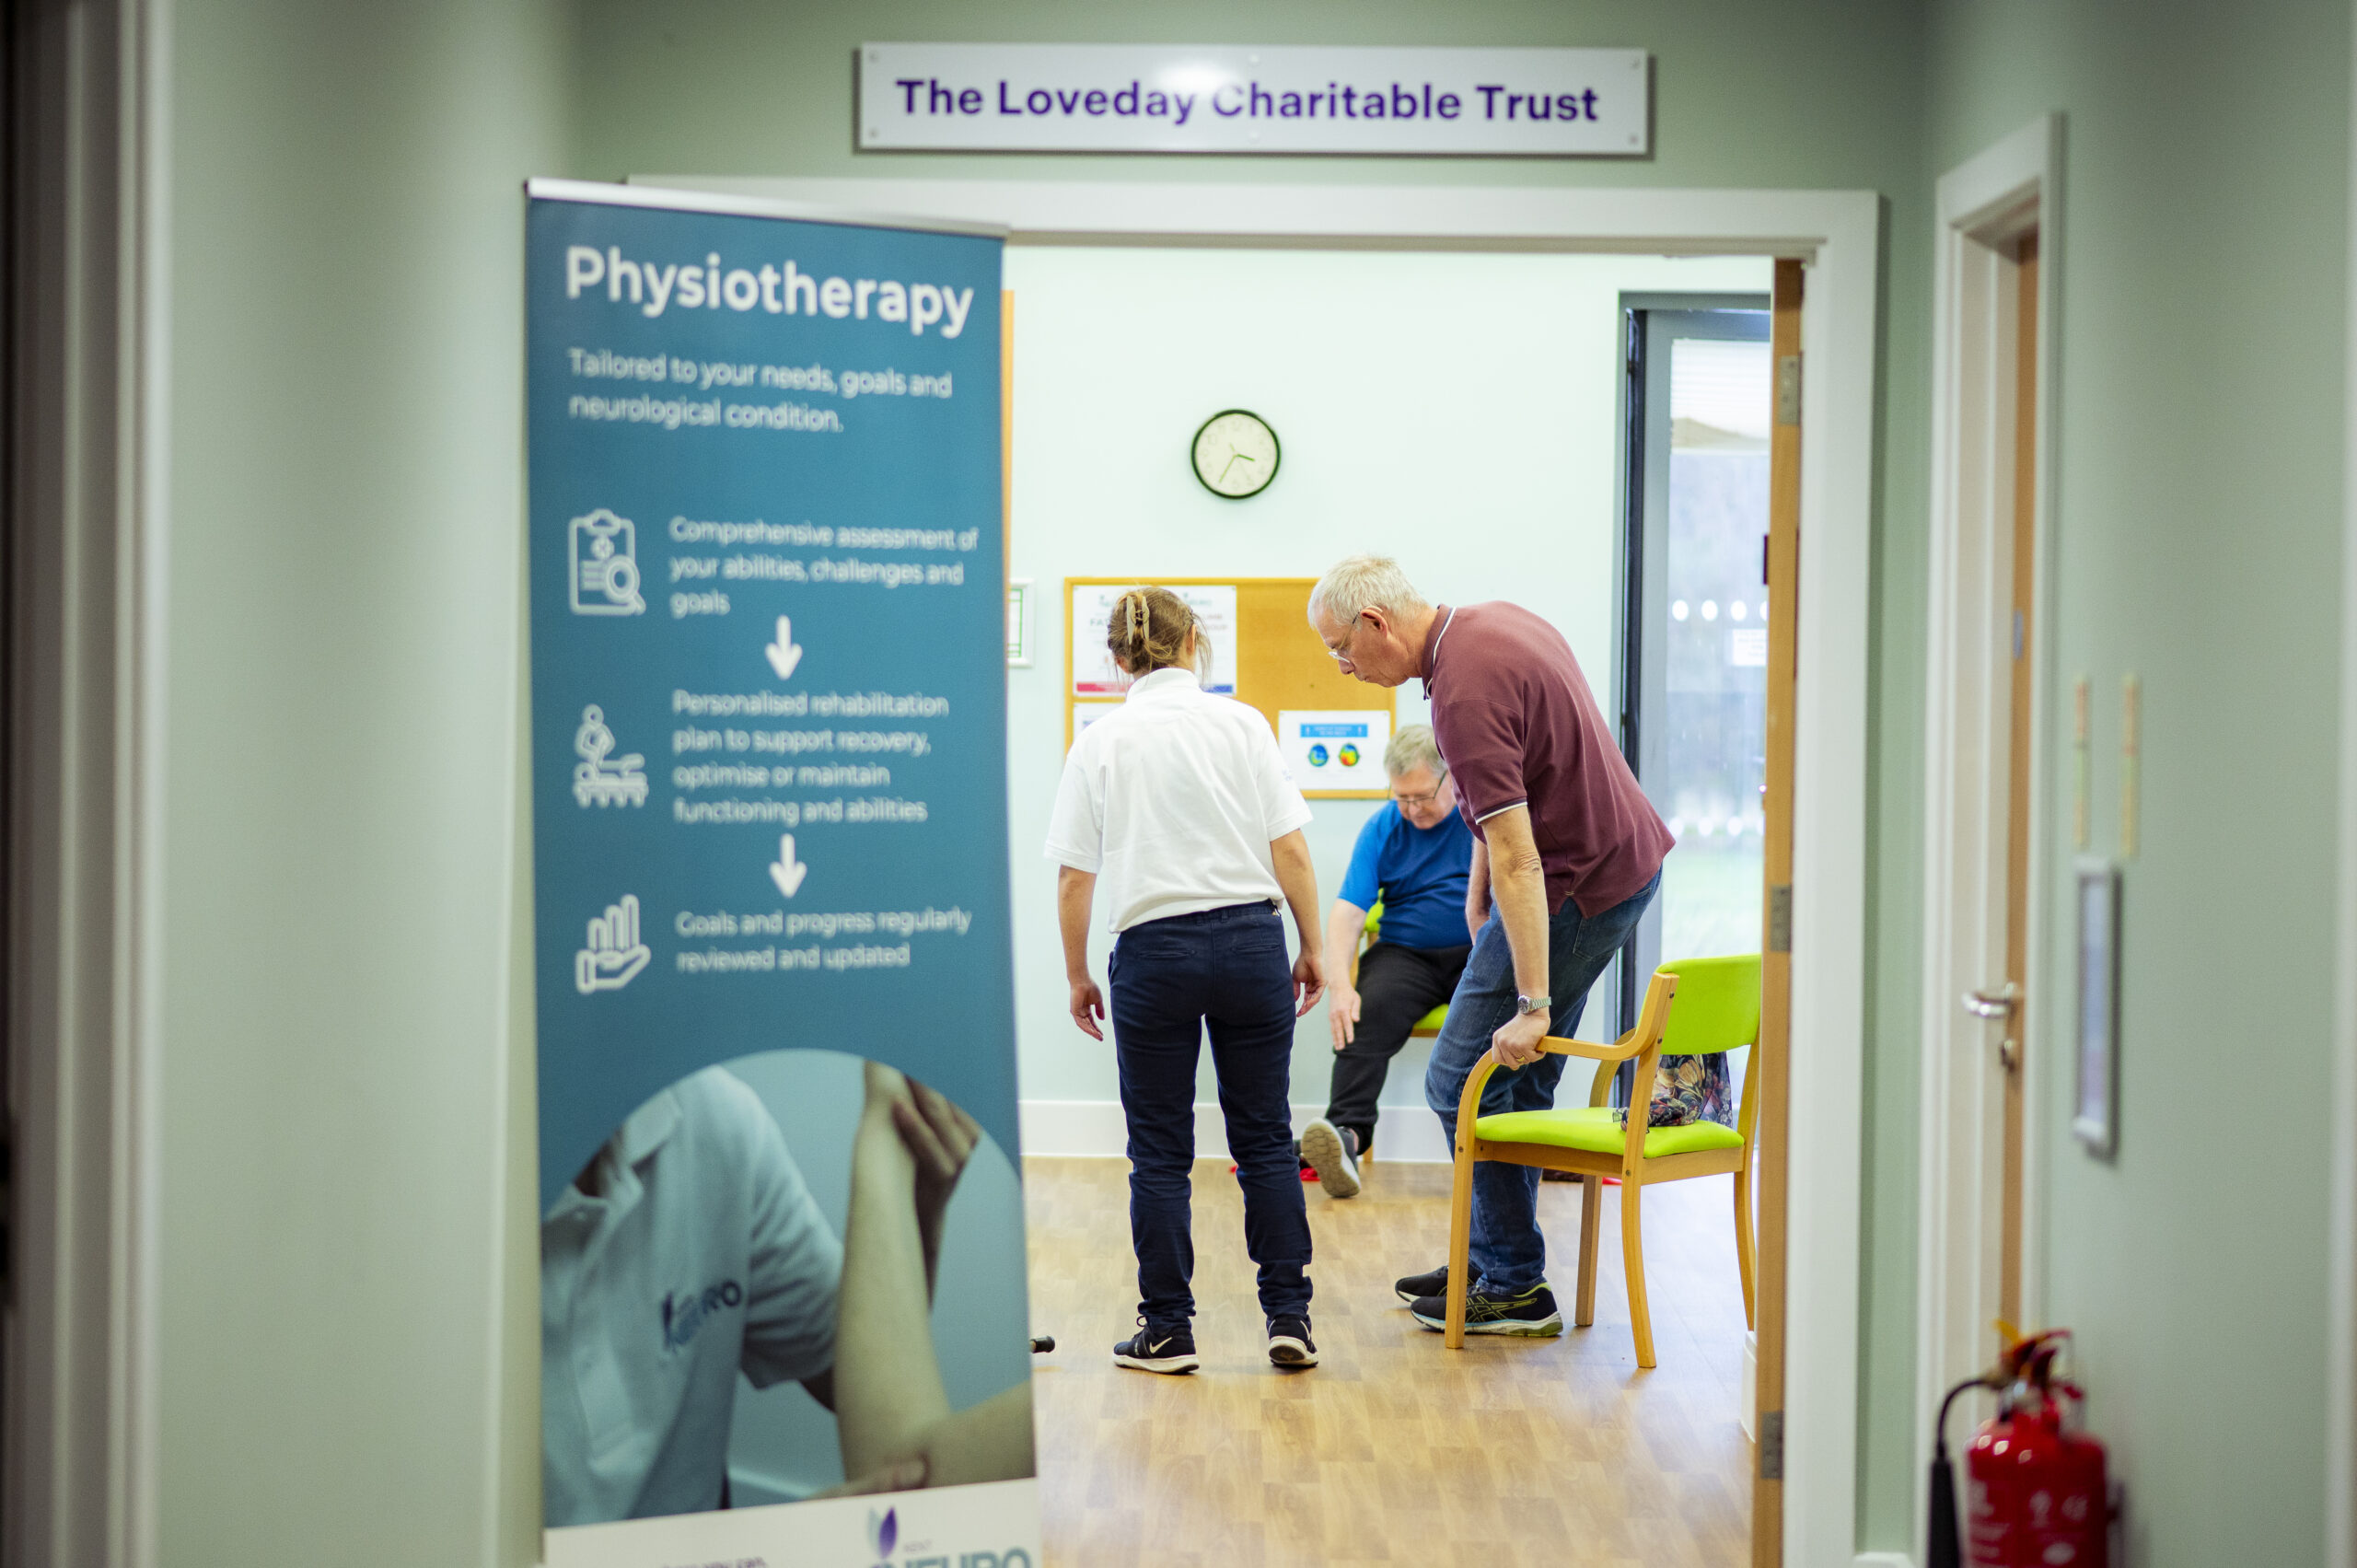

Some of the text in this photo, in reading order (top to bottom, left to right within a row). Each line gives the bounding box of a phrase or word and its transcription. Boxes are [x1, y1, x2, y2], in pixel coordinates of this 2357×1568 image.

[896, 78, 1599, 124] The Loveday Charitable Trust
[567, 245, 974, 338] Physiotherapy
[568, 348, 952, 398] Tailored to your needs, goals and
[569, 395, 844, 433] neurological condition.
[670, 516, 979, 552] Comprehensive assessment of
[669, 556, 718, 583] your
[811, 558, 923, 588] challenges
[926, 562, 964, 586] and
[670, 590, 730, 618] goals
[673, 689, 949, 718] Personalised rehabilitation
[673, 726, 722, 756] plan
[726, 727, 749, 750] to
[750, 728, 832, 755] support
[673, 761, 890, 791] optimise or maintain
[673, 796, 928, 828] functioning and abilities
[676, 906, 971, 937] Goals and progress regularly
[677, 942, 911, 973] reviewed and updated
